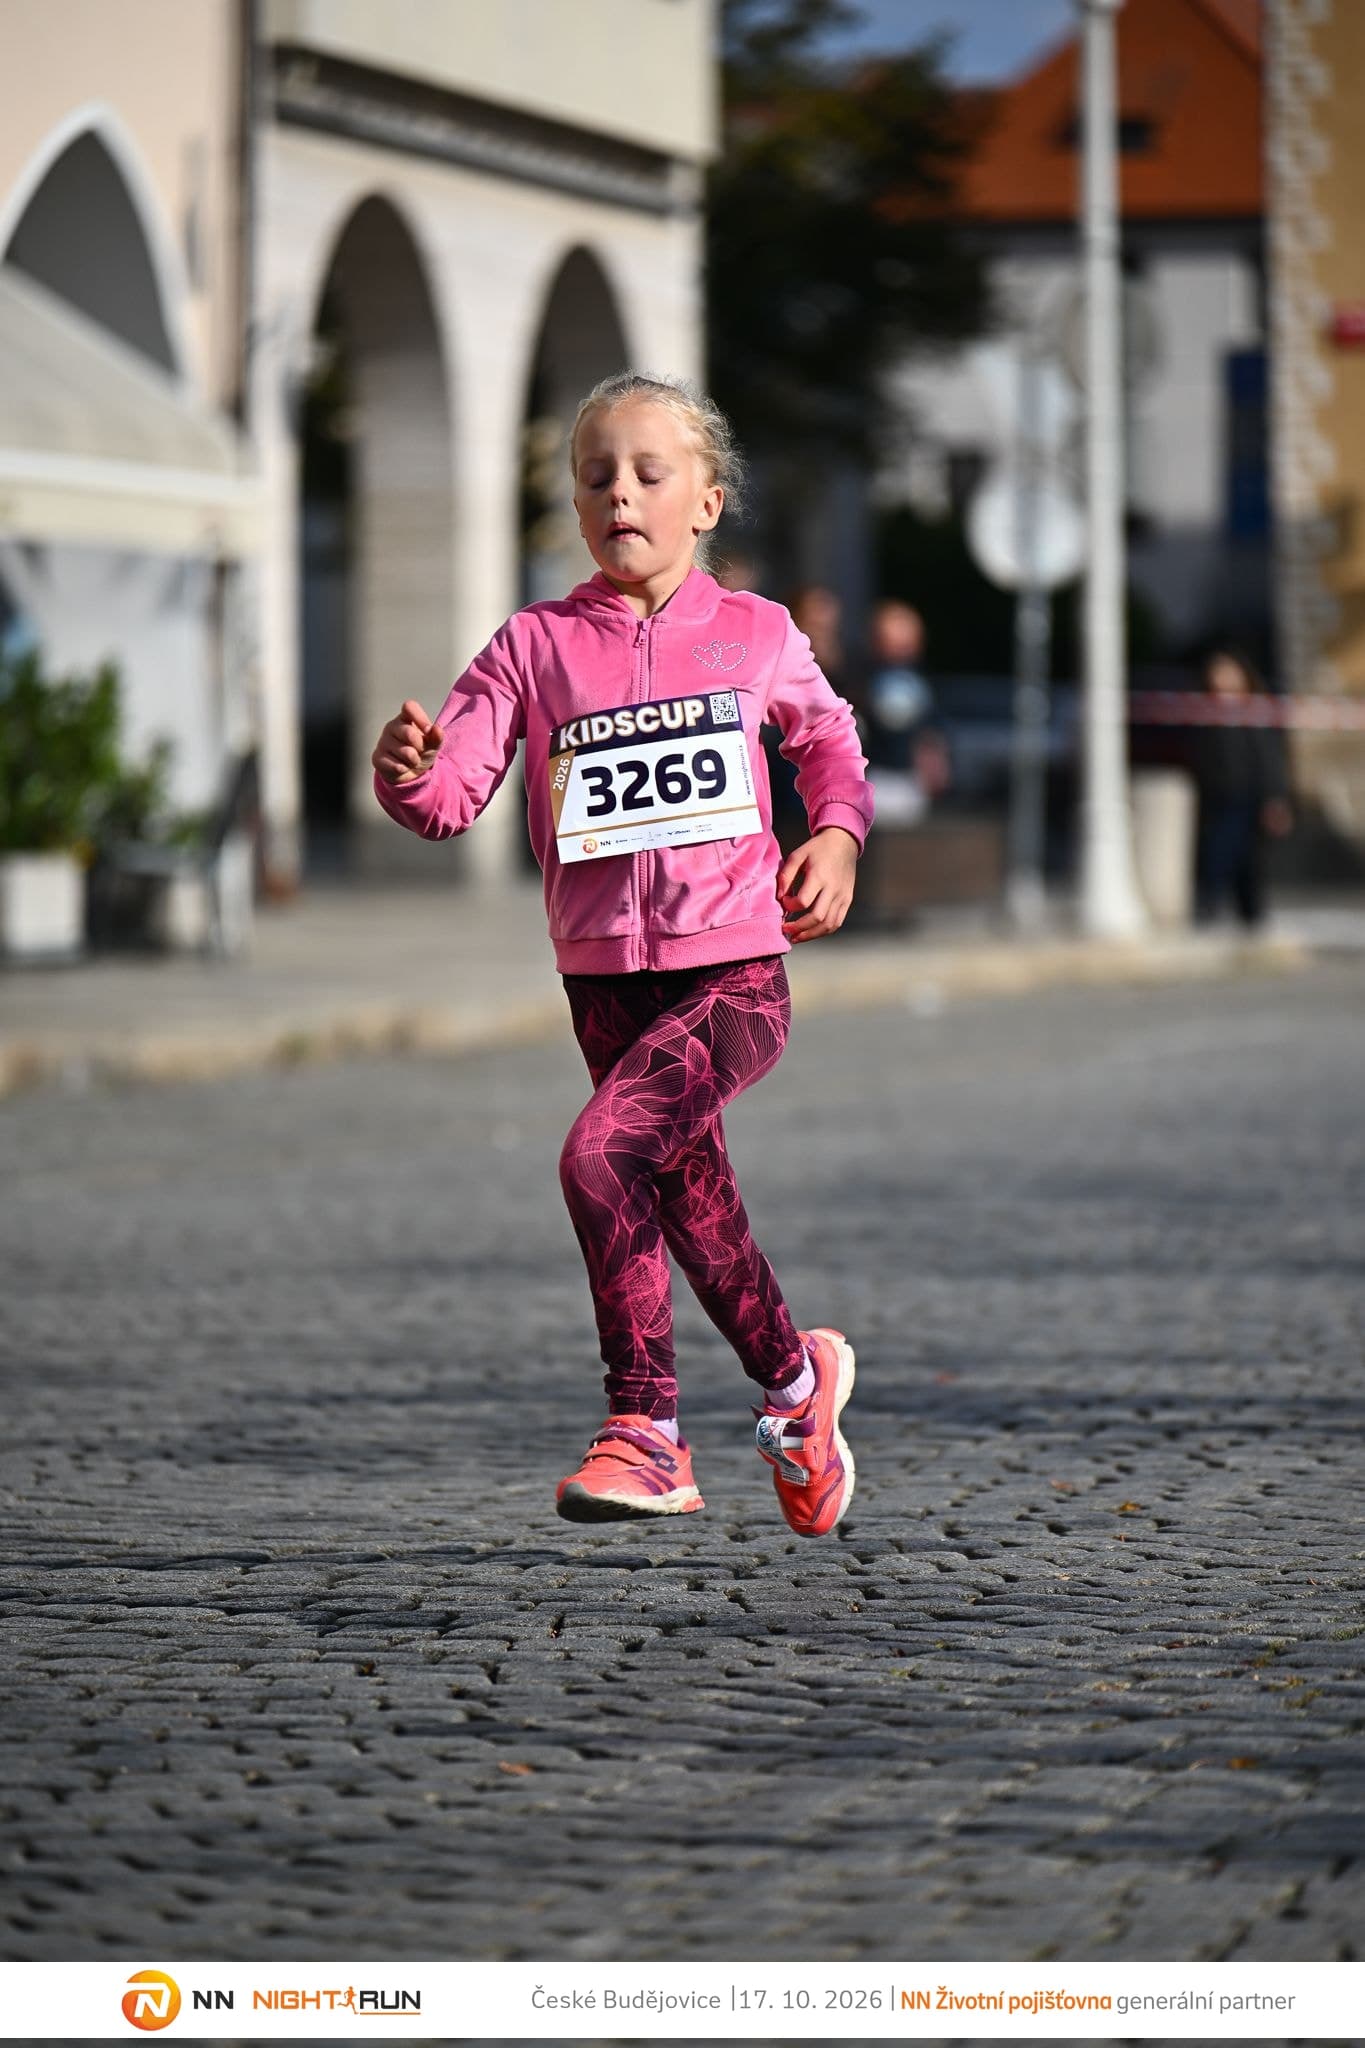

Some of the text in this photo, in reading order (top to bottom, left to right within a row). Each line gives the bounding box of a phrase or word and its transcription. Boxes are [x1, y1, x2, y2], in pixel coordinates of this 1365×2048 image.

[559, 699, 706, 750] KIDSCUP
[553, 758, 570, 791] 2026
[581, 748, 727, 817] 3269
